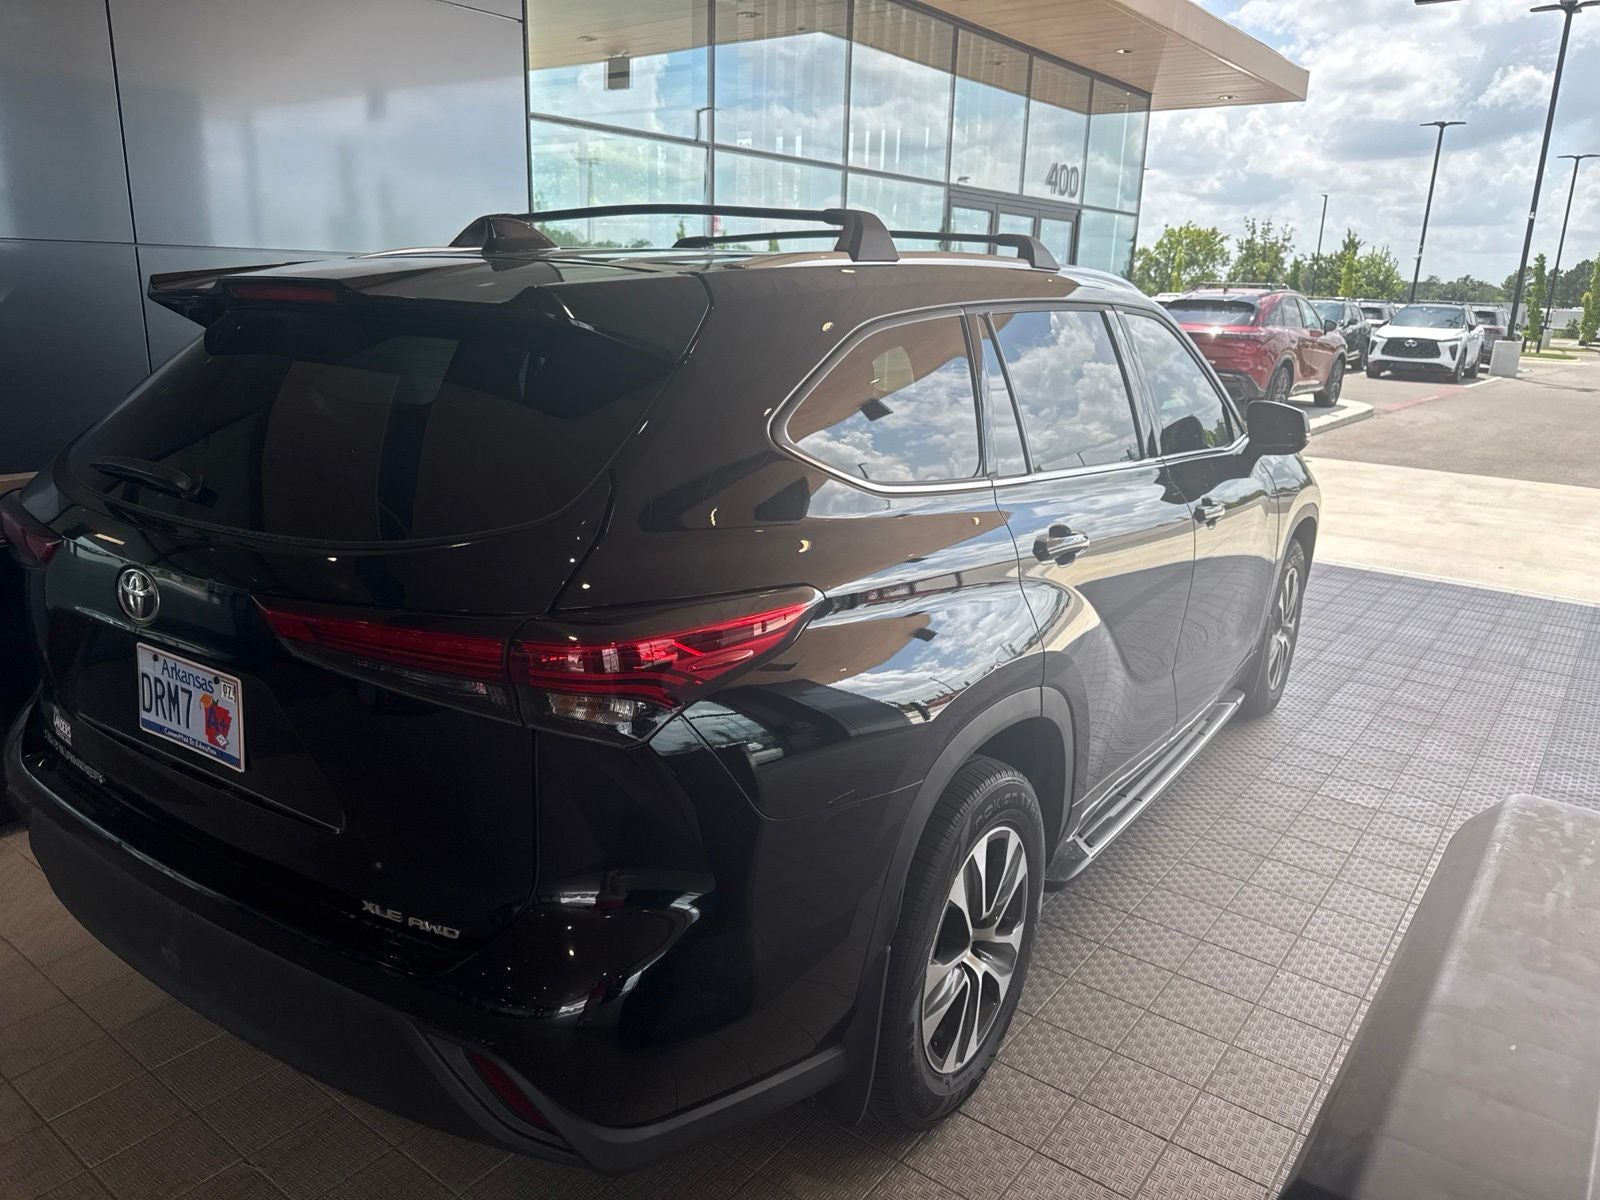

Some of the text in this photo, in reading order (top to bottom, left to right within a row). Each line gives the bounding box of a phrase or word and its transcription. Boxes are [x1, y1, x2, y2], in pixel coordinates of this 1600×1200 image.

[1044, 162, 1080, 198] 400
[161, 659, 215, 694] Arkansas
[141, 672, 193, 729] DRM7
[361, 899, 460, 939] XLE AWD
